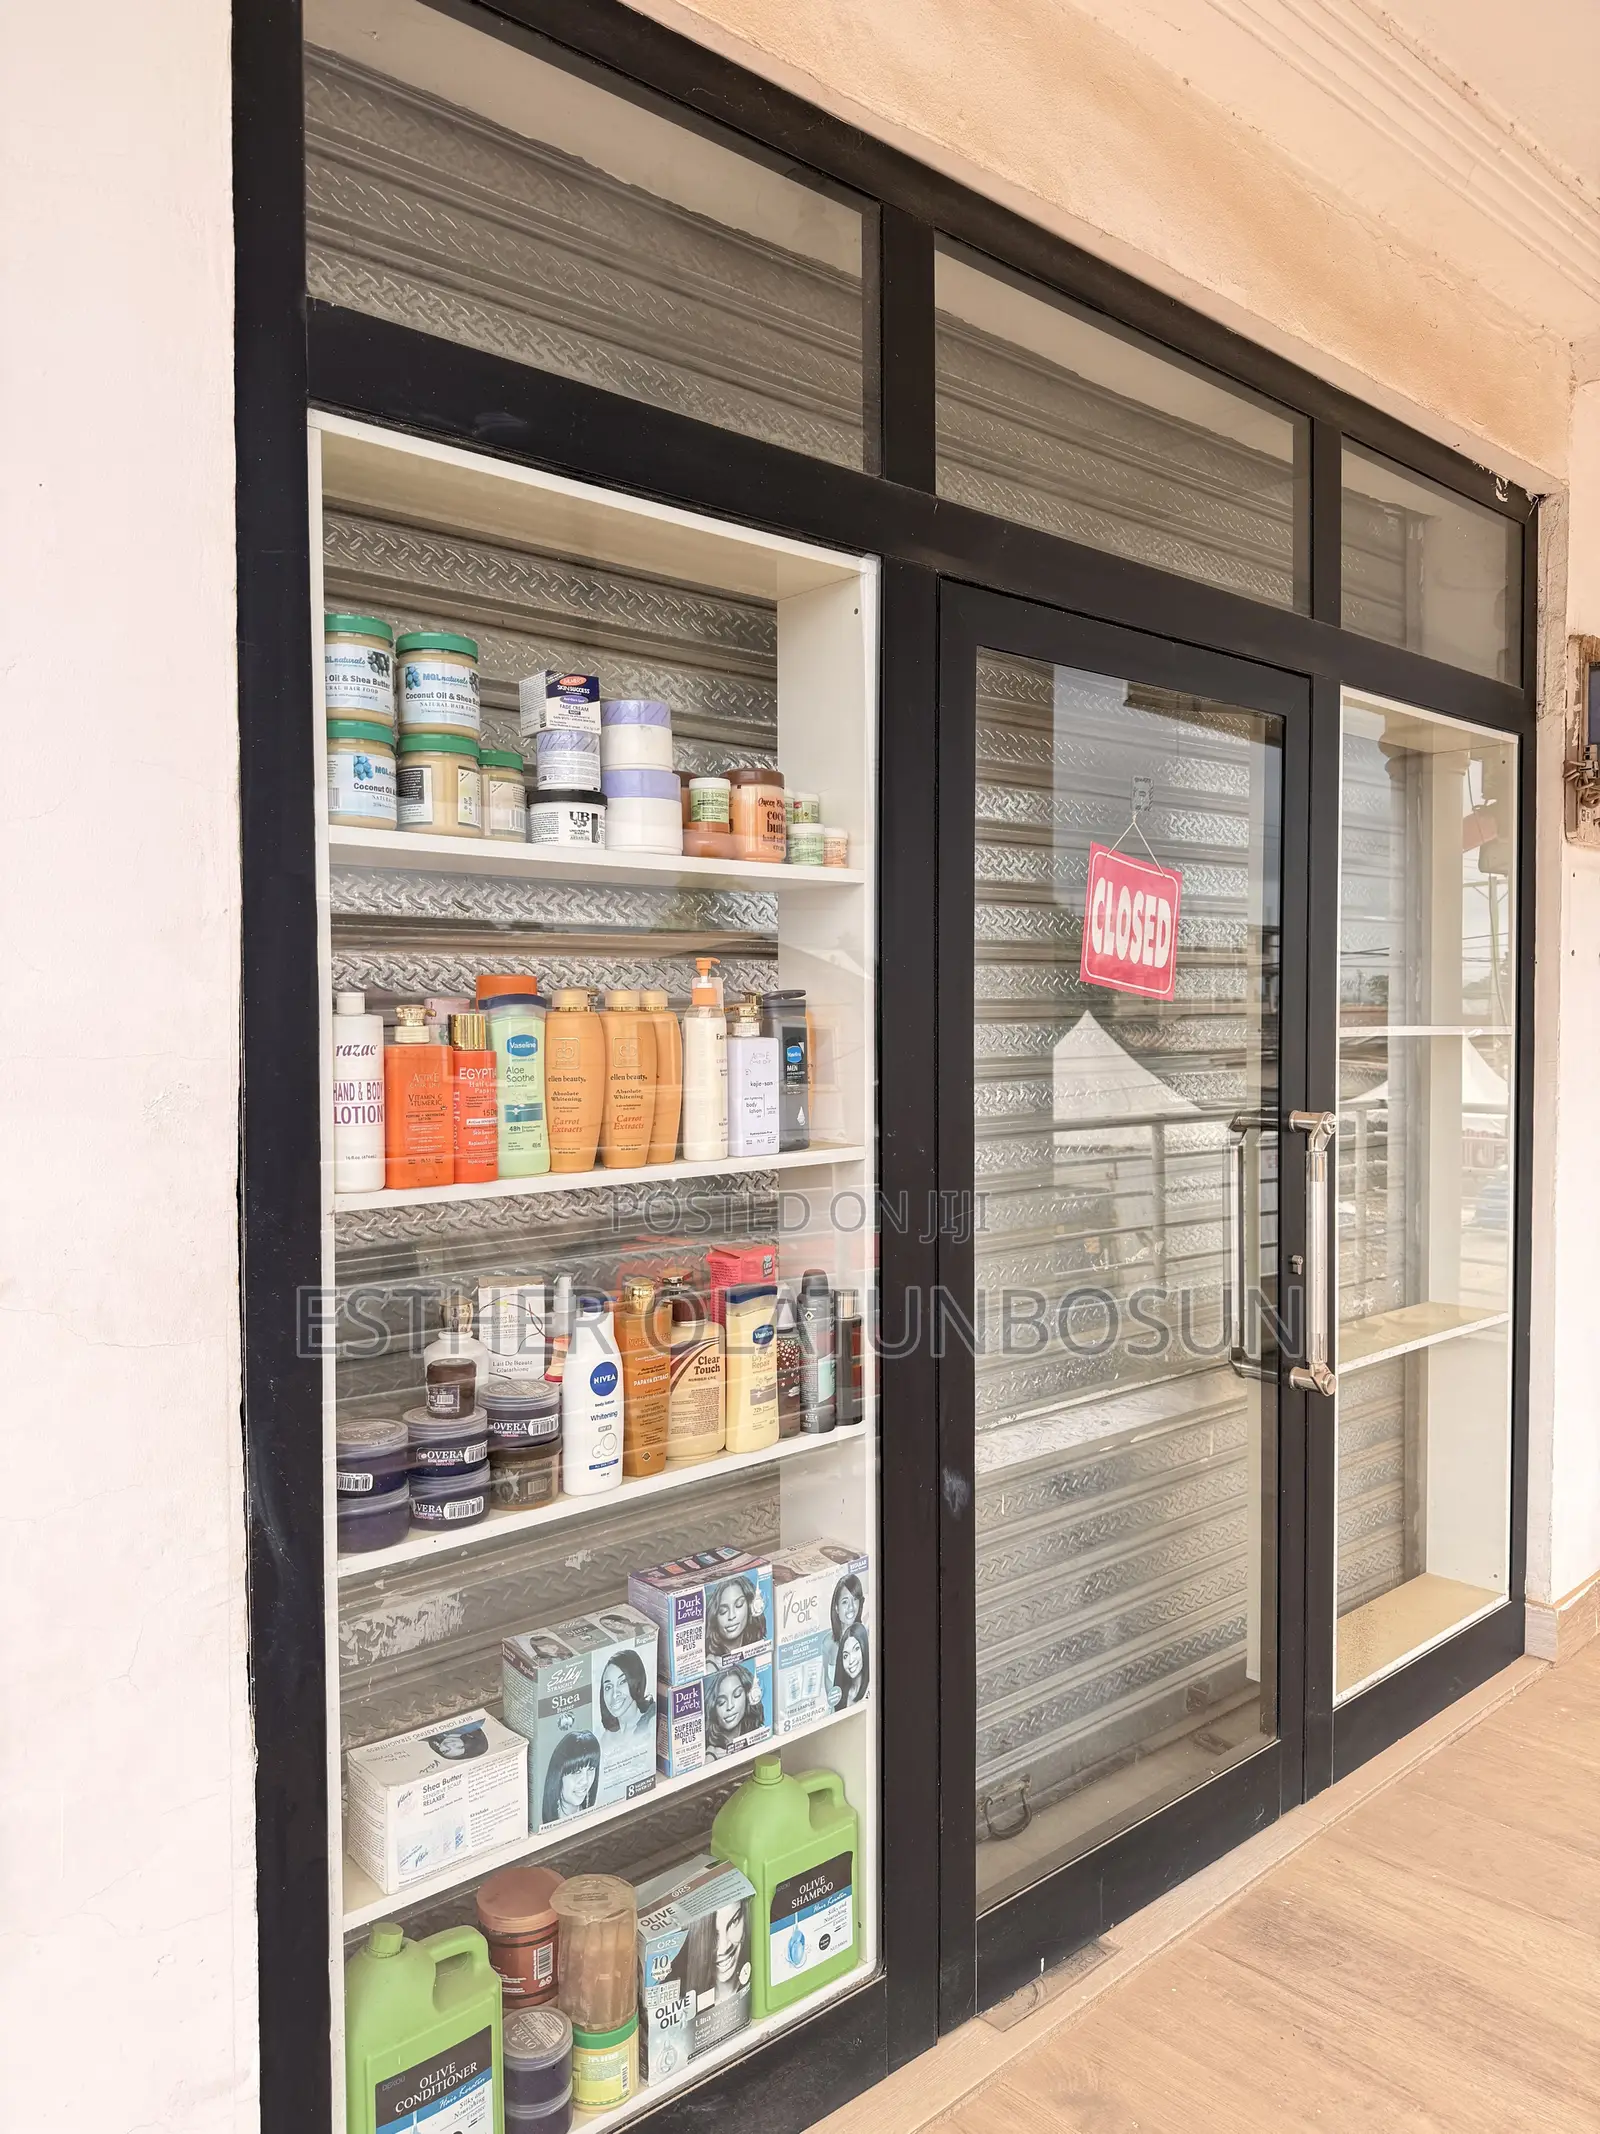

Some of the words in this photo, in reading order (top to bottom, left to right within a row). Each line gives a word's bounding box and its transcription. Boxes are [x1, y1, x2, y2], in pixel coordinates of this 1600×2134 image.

[351, 675, 371, 684] Shea
[405, 692, 434, 700] Coconut
[456, 694, 472, 703] Shea
[353, 782, 385, 793] Coconut
[766, 820, 785, 834] butt
[1091, 876, 1172, 969] CLOSED
[335, 1044, 378, 1057] razac
[510, 1041, 537, 1049] Vaseline
[505, 1066, 525, 1074] Aloe
[786, 1064, 799, 1072] MEN
[506, 1074, 535, 1083] Soothe
[610, 1073, 626, 1081] ellen
[333, 1083, 355, 1101] HAND
[358, 1082, 364, 1100] &
[408, 1094, 436, 1102] VITAMIN
[333, 1104, 384, 1124] LOTION
[553, 1115, 580, 1125] Carrot
[616, 1114, 643, 1123] Carrot
[551, 1124, 583, 1134] Extracts
[613, 1122, 644, 1131] Extracts
[697, 1356, 721, 1366] Clear
[751, 1359, 770, 1369] Repair
[693, 1363, 721, 1375] Touch
[593, 1374, 617, 1385] NIVEA
[590, 1410, 619, 1422] Whitening
[493, 1421, 528, 1432] OVERA
[427, 1450, 464, 1460] OVERA
[677, 1595, 702, 1611] Dark
[677, 1607, 704, 1620] Lovely
[797, 1609, 813, 1624] OIL
[675, 1626, 703, 1641] SUPERIOR
[675, 1633, 703, 1648] MOISTURE
[682, 1642, 697, 1653] PLUS
[547, 1666, 584, 1687] Silky
[551, 1692, 581, 1709] Shea
[675, 1687, 700, 1704] Dark
[556, 1703, 575, 1714] Butter
[676, 1698, 701, 1714] Lovely
[791, 1713, 811, 1725] SALON
[811, 1706, 826, 1719] PACK
[674, 1718, 702, 1734] SUPERIOR
[783, 1719, 791, 1732] 8
[674, 1725, 702, 1741] MOISTURE
[681, 1734, 697, 1746] PLUS
[422, 1781, 441, 1794] Shea
[441, 1773, 464, 1787] Butter
[627, 1785, 635, 1797] 8
[422, 1793, 446, 1808] RELAXER
[671, 1884, 691, 1898] ORS
[799, 1875, 826, 1895] OLIVE
[791, 1881, 834, 1909] SHAMPOO
[838, 1901, 848, 1910] and
[640, 1906, 676, 1927] OLIVE
[650, 1920, 672, 1932] OIL
[657, 1938, 677, 1950] ORS
[652, 1954, 669, 1970] 10
[659, 1988, 678, 2003] FREE
[655, 1995, 691, 2020] OLIVE
[659, 2014, 681, 2030] OIL
[695, 2015, 711, 2027] Ultra
[419, 2062, 457, 2090] OLIVE
[395, 2061, 478, 2114] CONDITIONER
[439, 2096, 458, 2110] Hair
[459, 2096, 474, 2110] Silky
[474, 2088, 486, 2099] and
[453, 2096, 486, 2120] Nourishing
